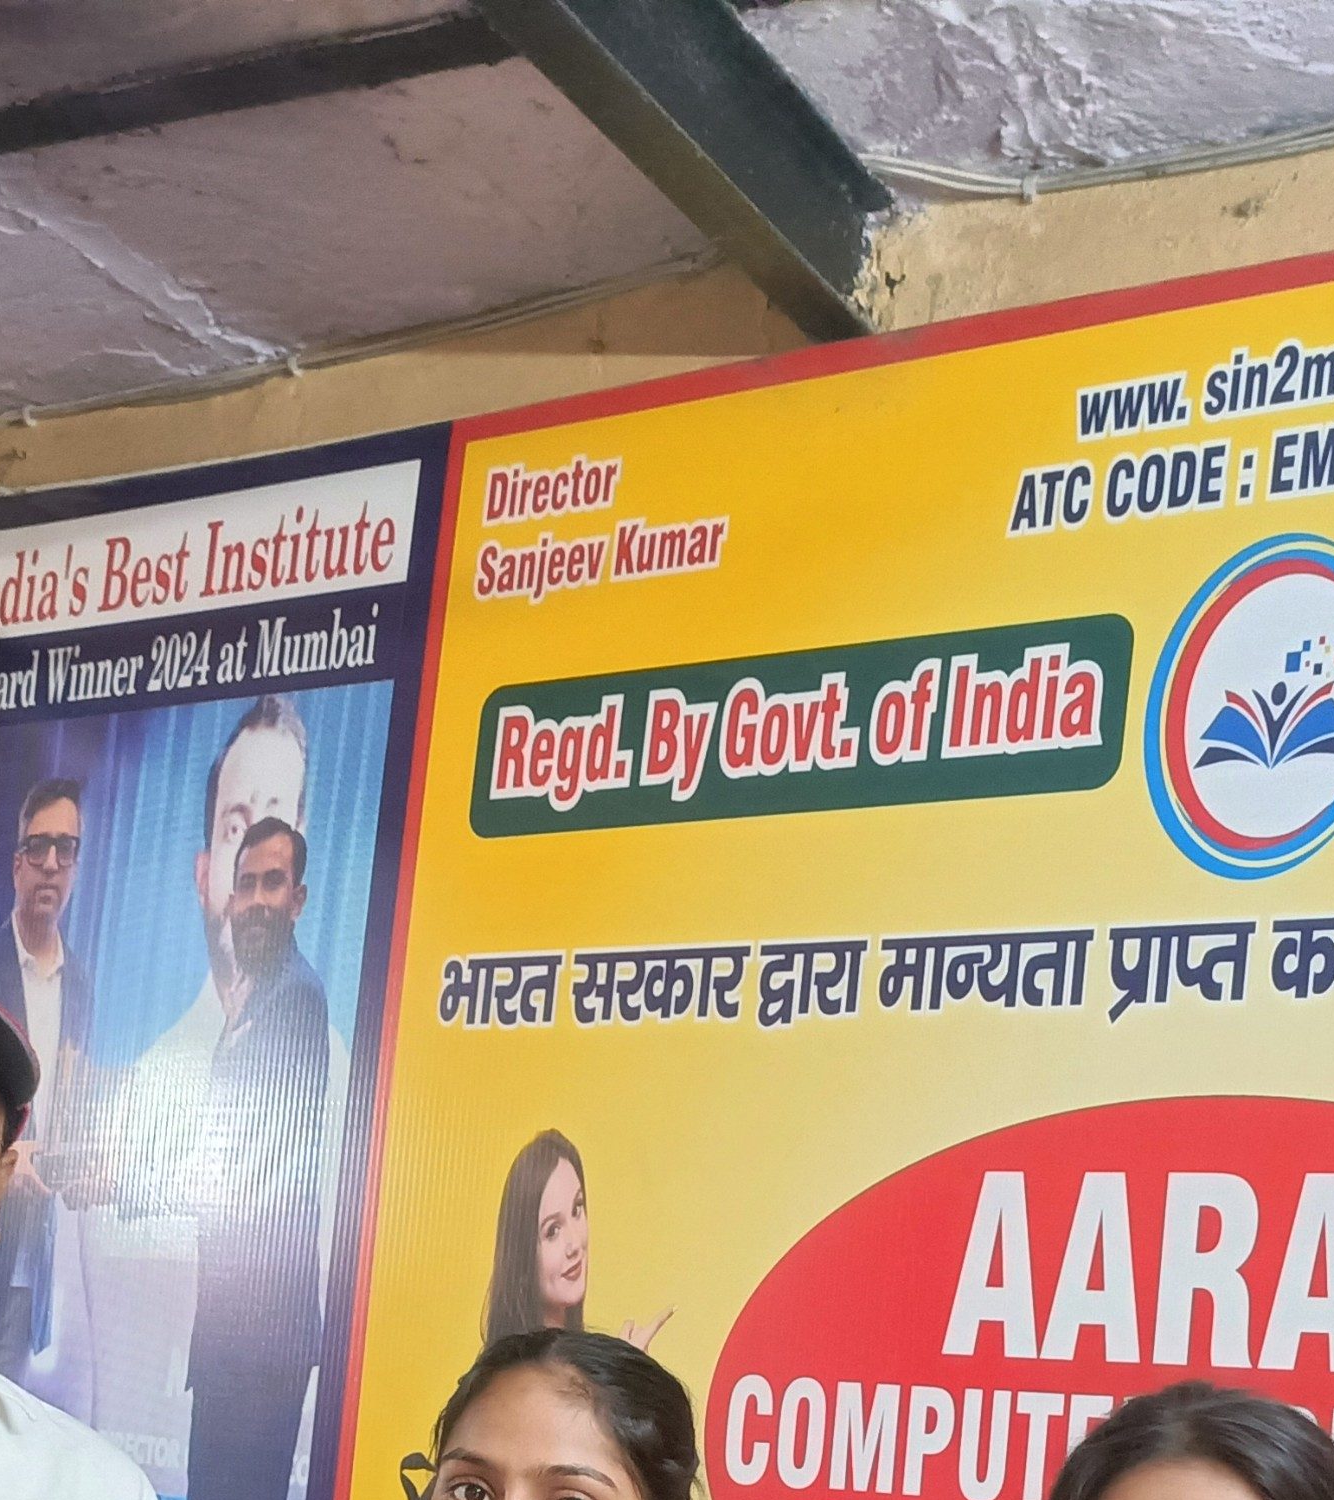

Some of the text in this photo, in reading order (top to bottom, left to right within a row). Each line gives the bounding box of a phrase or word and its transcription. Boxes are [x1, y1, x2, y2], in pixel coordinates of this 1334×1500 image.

[1079, 378, 1187, 437] www.
[486, 458, 619, 520] Director
[1010, 464, 1092, 533] ATC
[1106, 446, 1224, 518] CODE
[98, 531, 190, 613] Best
[199, 501, 396, 598] Institute
[475, 520, 726, 602] Sanjeev Kumar
[46, 640, 143, 702] Winner
[147, 631, 212, 694] 2024
[216, 634, 247, 682] at
[252, 604, 378, 679] Mumbai
[496, 655, 1095, 803] Regd. By Govt. of India
[441, 950, 562, 1026] भारत
[573, 944, 750, 1022] सरकार
[759, 940, 866, 1026] द्वारा
[879, 930, 1093, 1010] मान्यता
[1108, 922, 1255, 1022] प्राप्त
